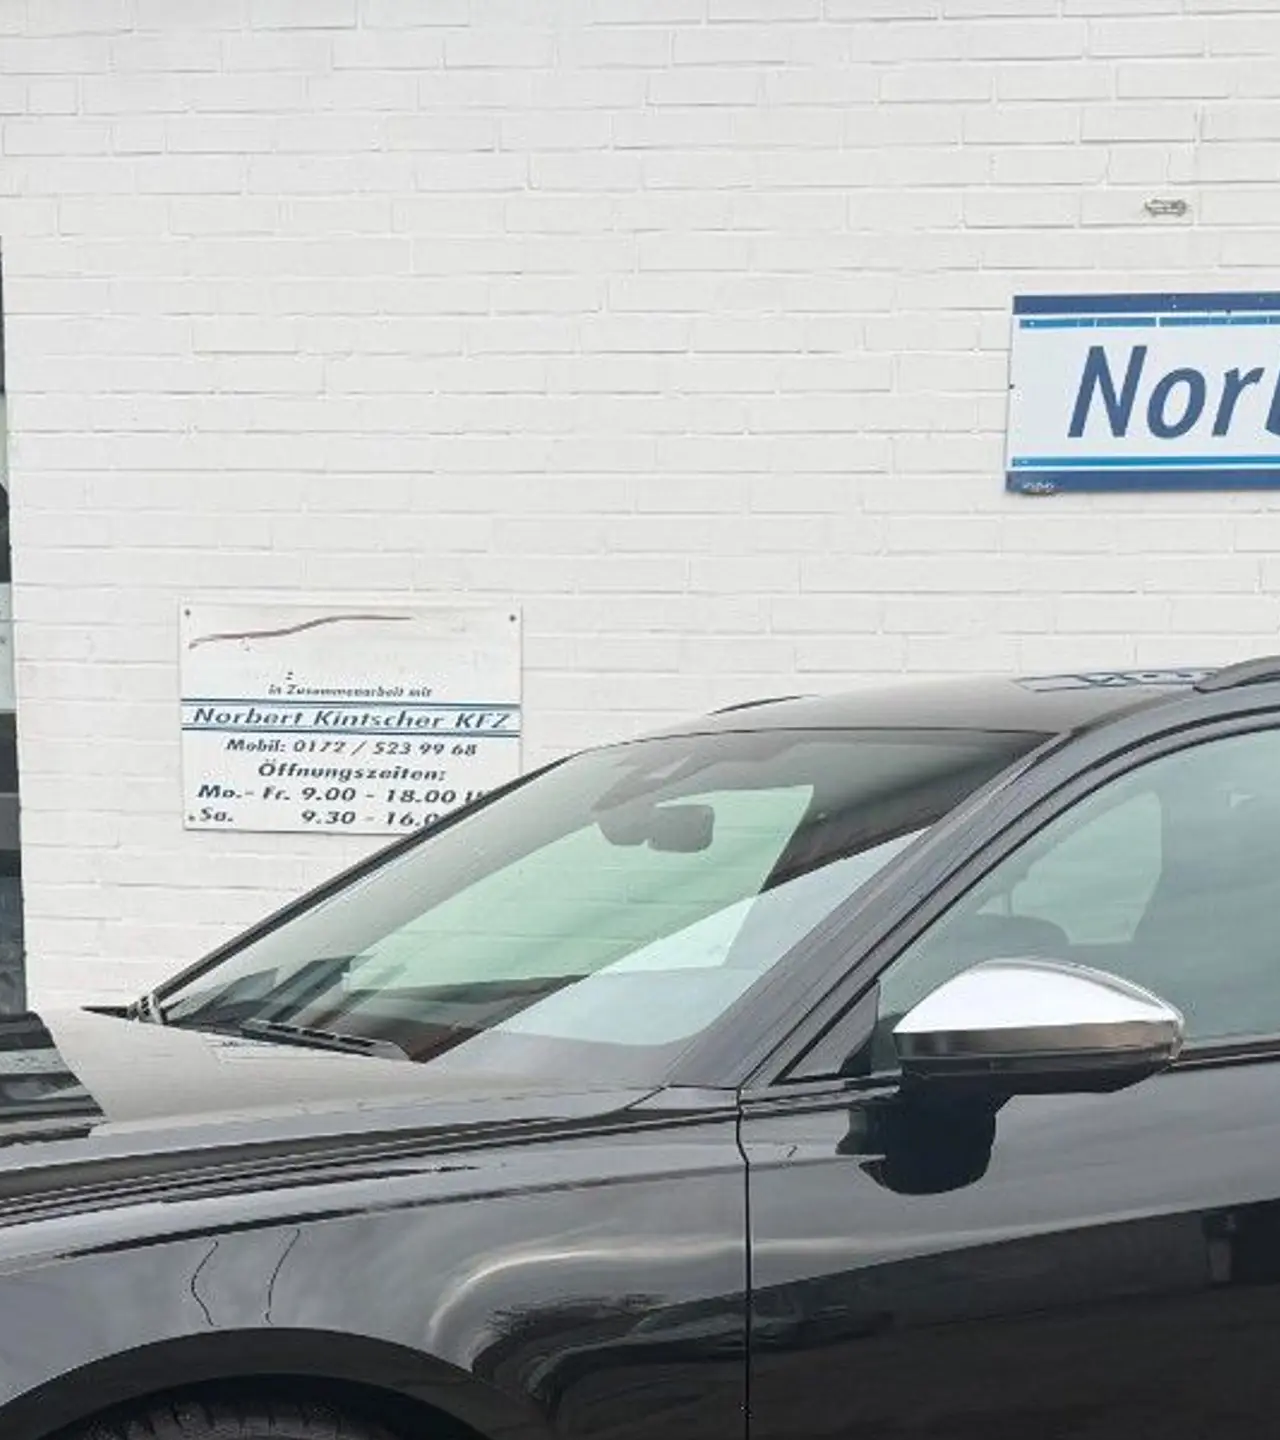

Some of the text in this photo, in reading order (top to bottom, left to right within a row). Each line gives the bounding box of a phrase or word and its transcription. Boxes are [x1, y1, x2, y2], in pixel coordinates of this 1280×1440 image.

[268, 684, 432, 697] in Zusammenarbeit mit
[193, 708, 511, 729] Norbert Kintscher KFZ
[226, 739, 286, 753] Mobil:
[293, 739, 346, 753] 0172
[372, 741, 412, 755] 523
[420, 743, 445, 755] 99
[451, 743, 477, 756] 68
[258, 759, 446, 783] Öffnungszeiten:
[263, 786, 291, 800] Fr.
[301, 786, 357, 802] 9.00
[387, 789, 457, 803] 18.00
[200, 807, 234, 822] Sa.
[301, 809, 357, 825] 9.30
